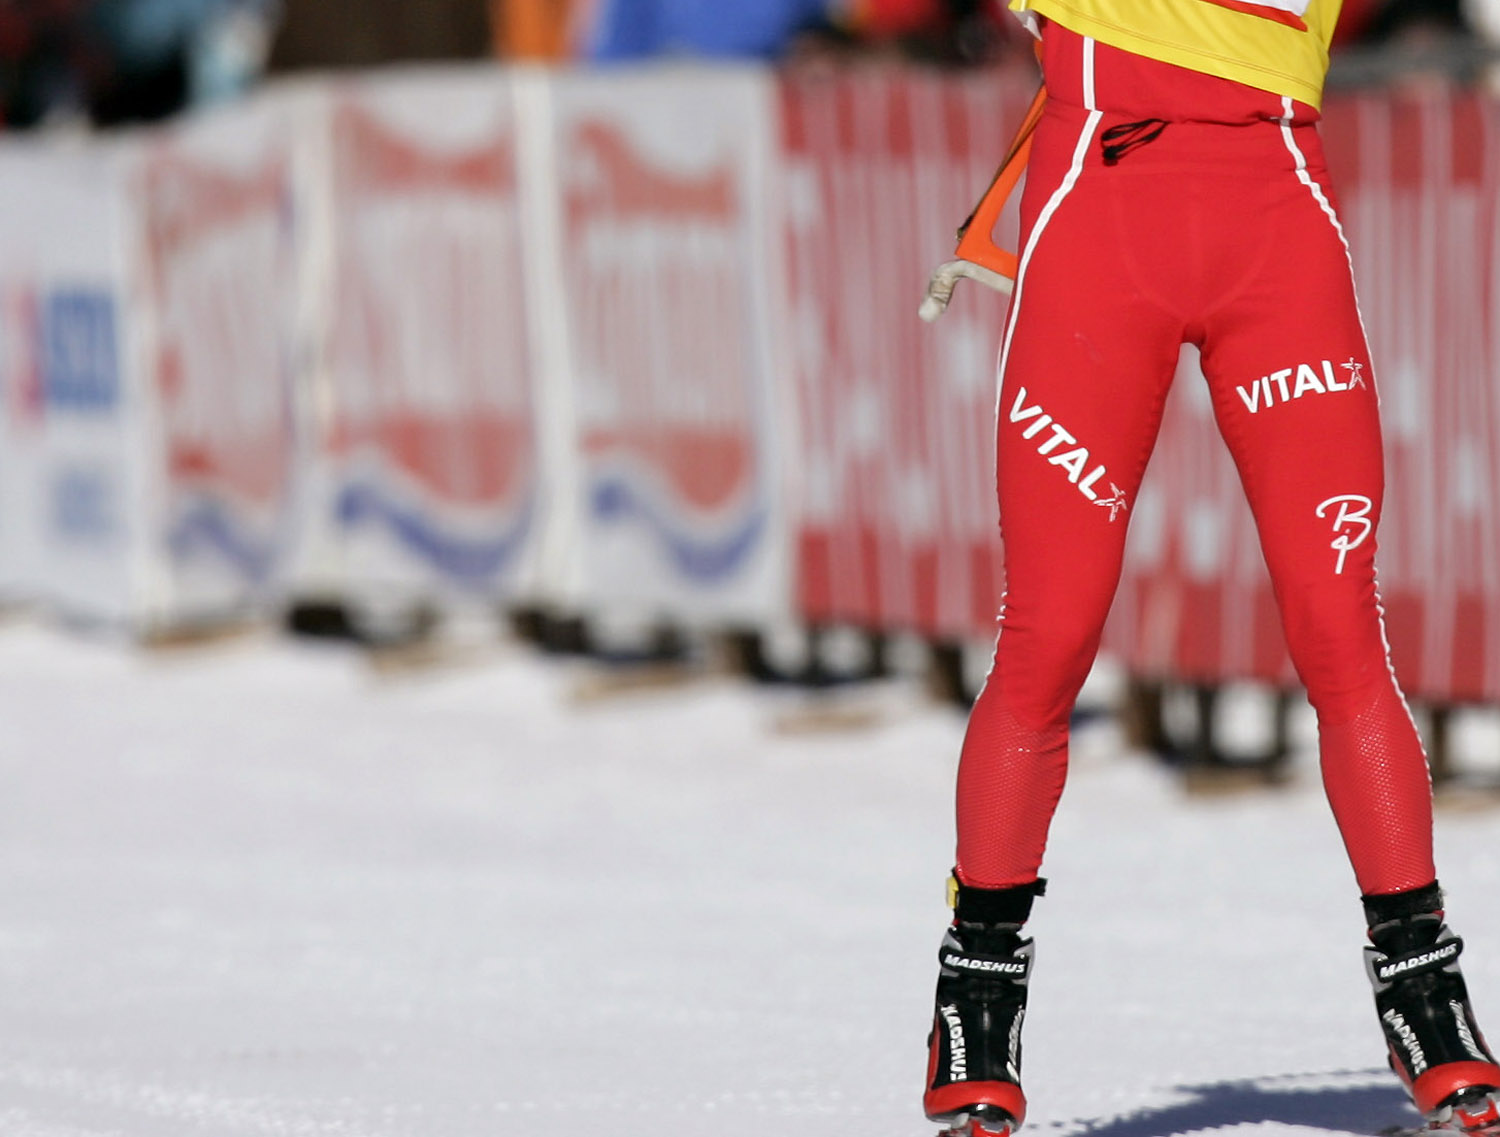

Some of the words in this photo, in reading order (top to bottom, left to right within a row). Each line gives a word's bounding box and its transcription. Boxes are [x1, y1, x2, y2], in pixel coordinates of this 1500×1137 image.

[1236, 360, 1348, 414] VITAL
[1009, 386, 1107, 502] VITAL
[944, 953, 1025, 974] MADSHUS
[1379, 942, 1458, 979] MADSHUS
